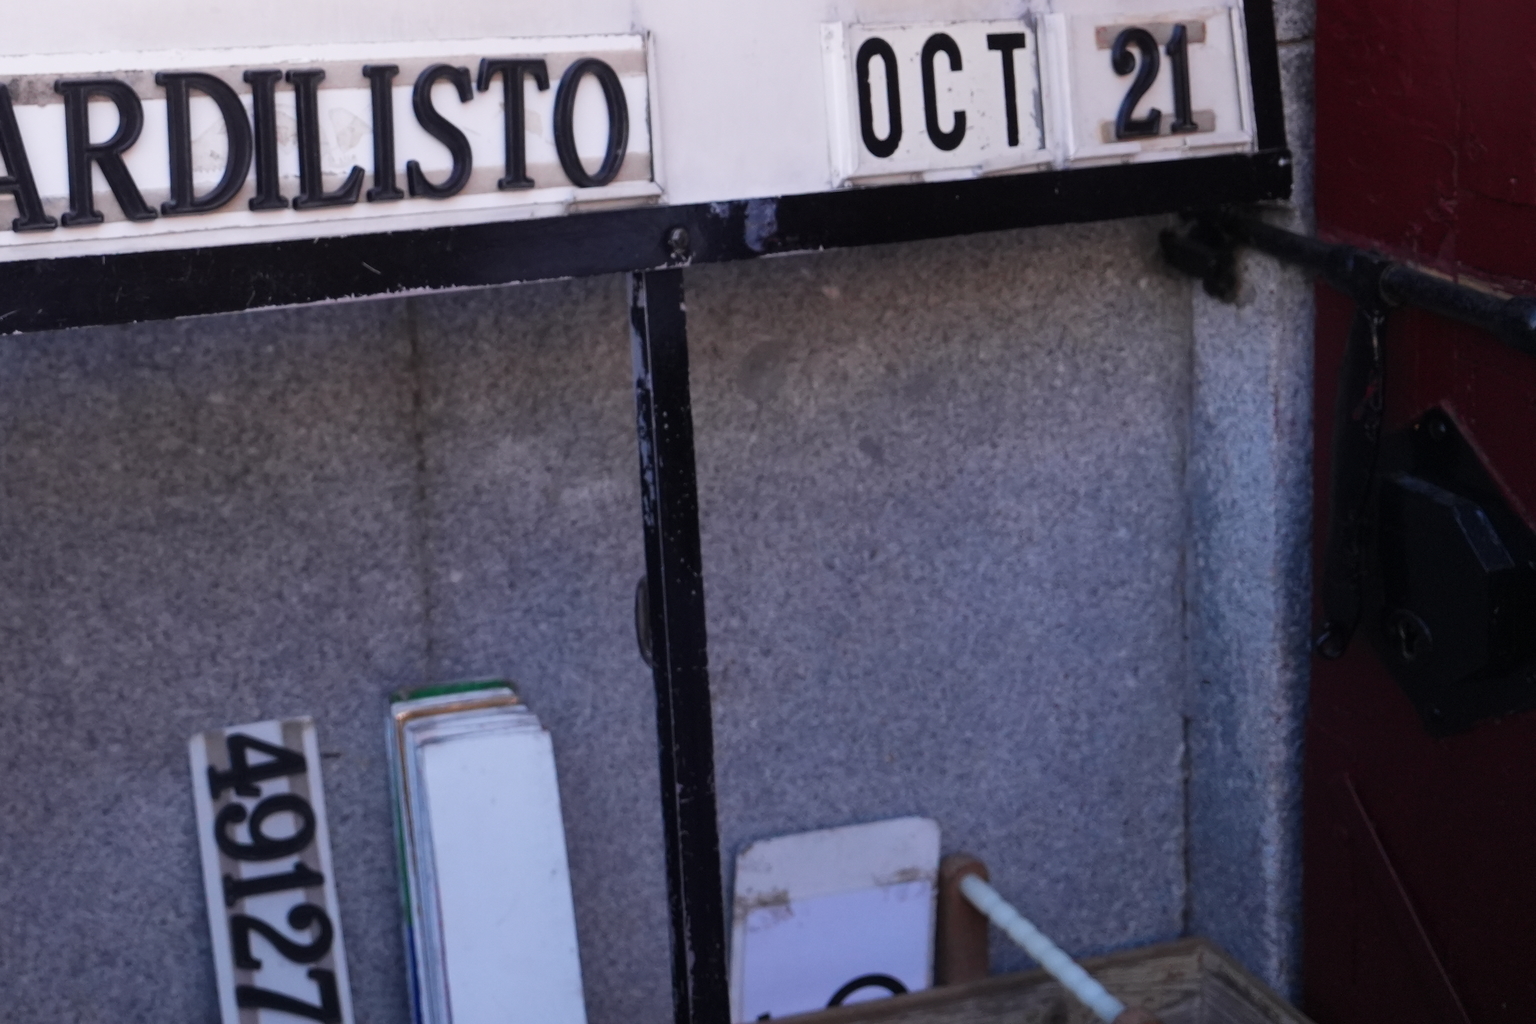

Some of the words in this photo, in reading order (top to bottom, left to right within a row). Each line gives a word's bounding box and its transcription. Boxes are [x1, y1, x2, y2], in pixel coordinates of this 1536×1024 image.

[855, 32, 1027, 160] OCT
[1110, 23, 1200, 143] 21
[207, 732, 341, 1024] 49127
